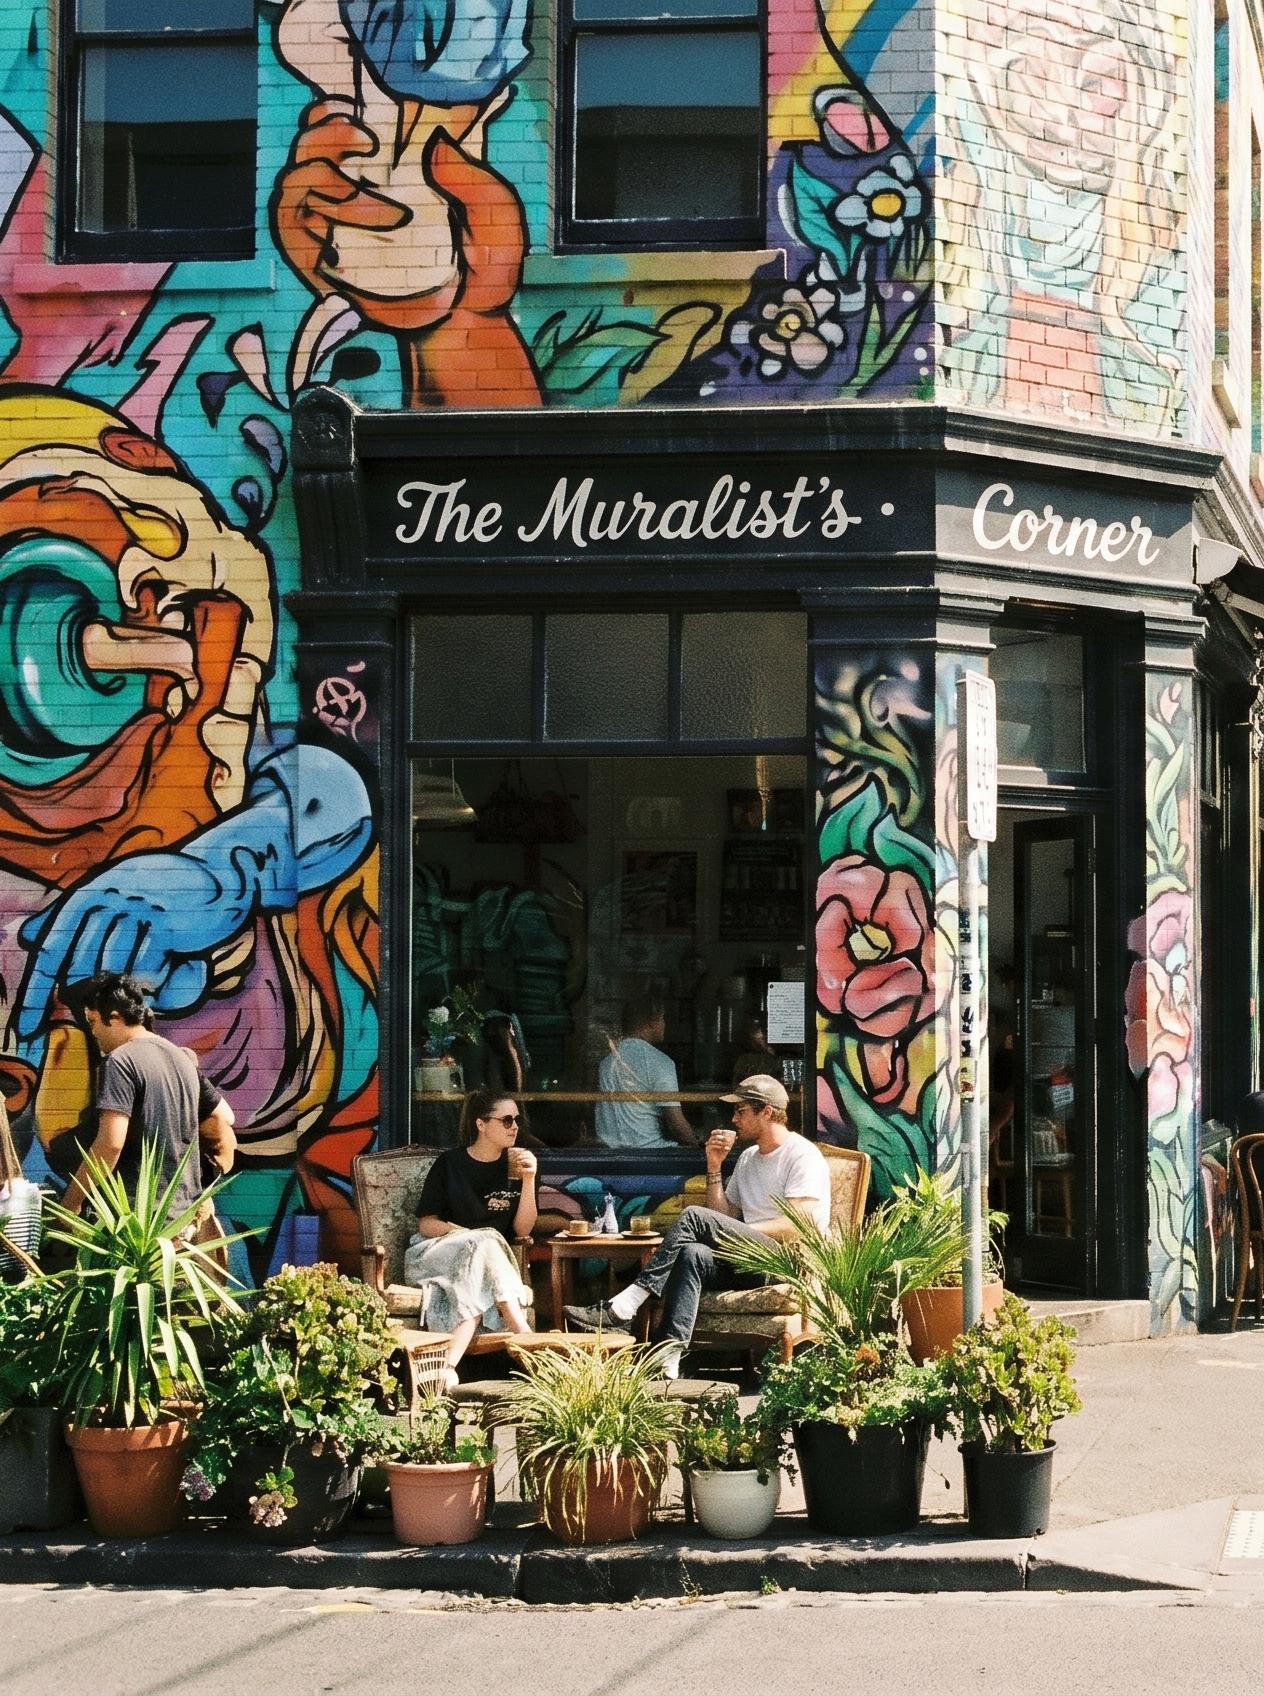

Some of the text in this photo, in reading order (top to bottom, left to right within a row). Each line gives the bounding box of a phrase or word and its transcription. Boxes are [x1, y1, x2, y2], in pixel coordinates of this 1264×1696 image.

[395, 474, 1160, 567] The Muralist's Corner
